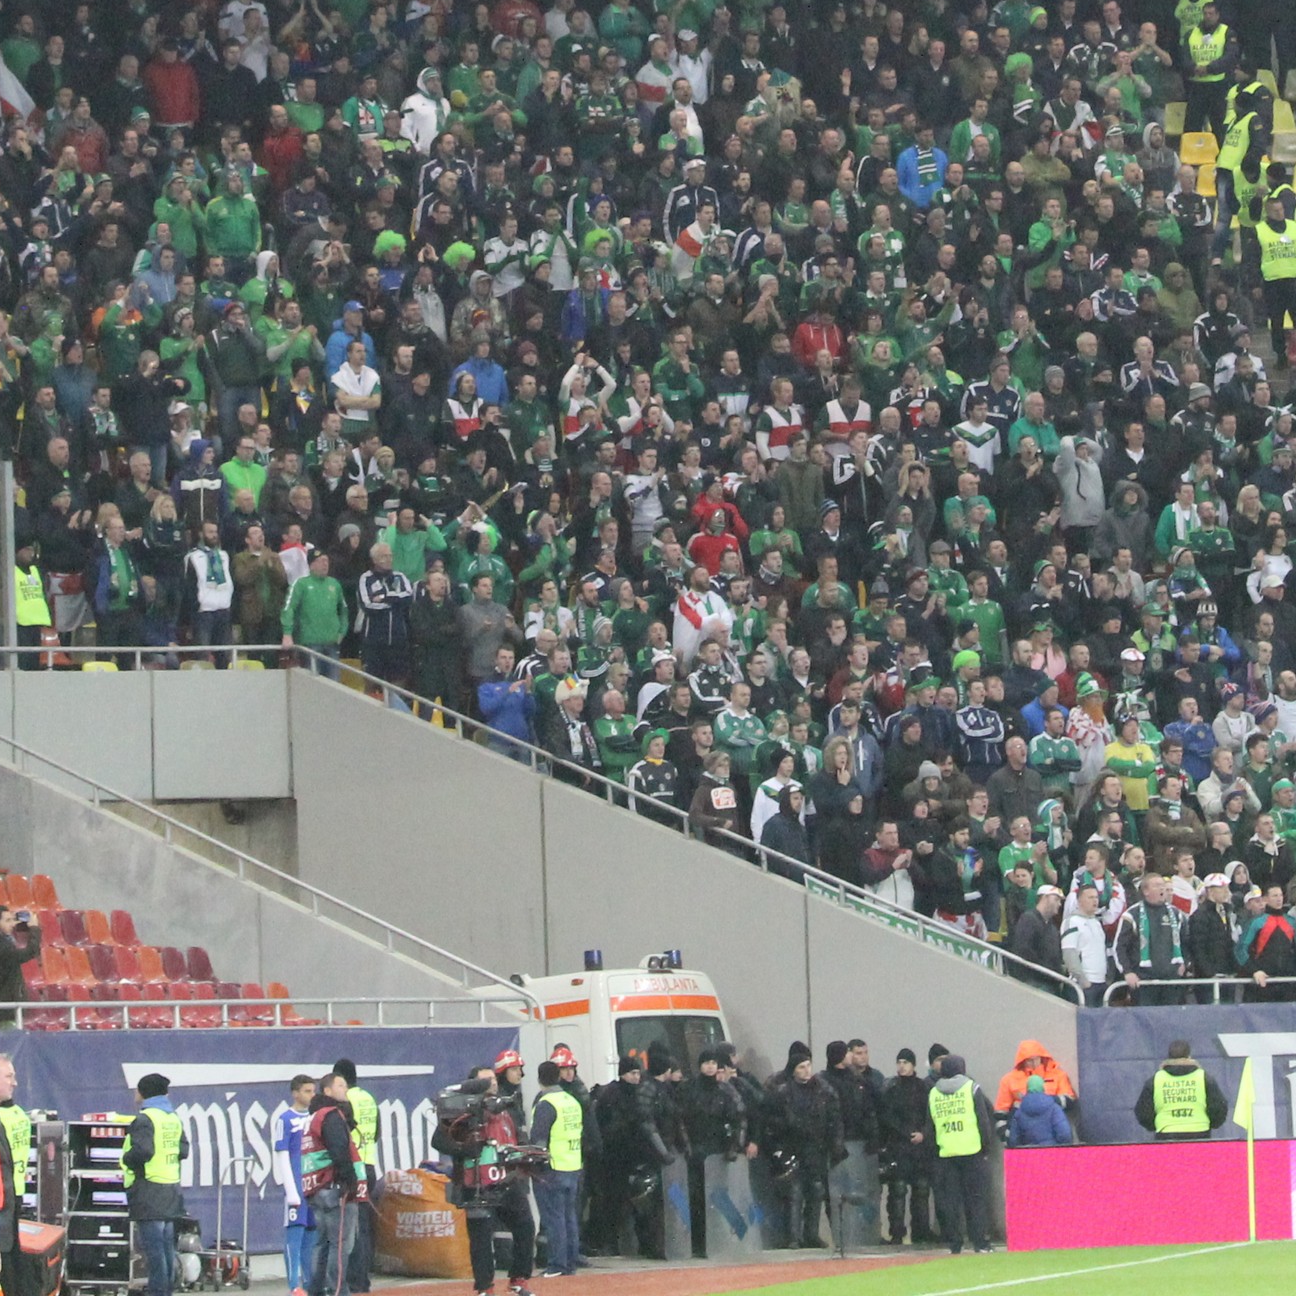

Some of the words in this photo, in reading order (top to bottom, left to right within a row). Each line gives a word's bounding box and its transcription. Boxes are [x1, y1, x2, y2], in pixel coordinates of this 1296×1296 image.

[634, 978, 700, 992] ABULANTA
[1162, 1080, 1196, 1089] ALISTAR
[934, 1092, 965, 1103] ALISTAR
[1163, 1088, 1197, 1097] SECURITY
[1163, 1095, 1197, 1104] STEWARD
[935, 1100, 965, 1111] SECURITY
[935, 1108, 966, 1118] STEWARD
[396, 1210, 454, 1225] VORTEIL
